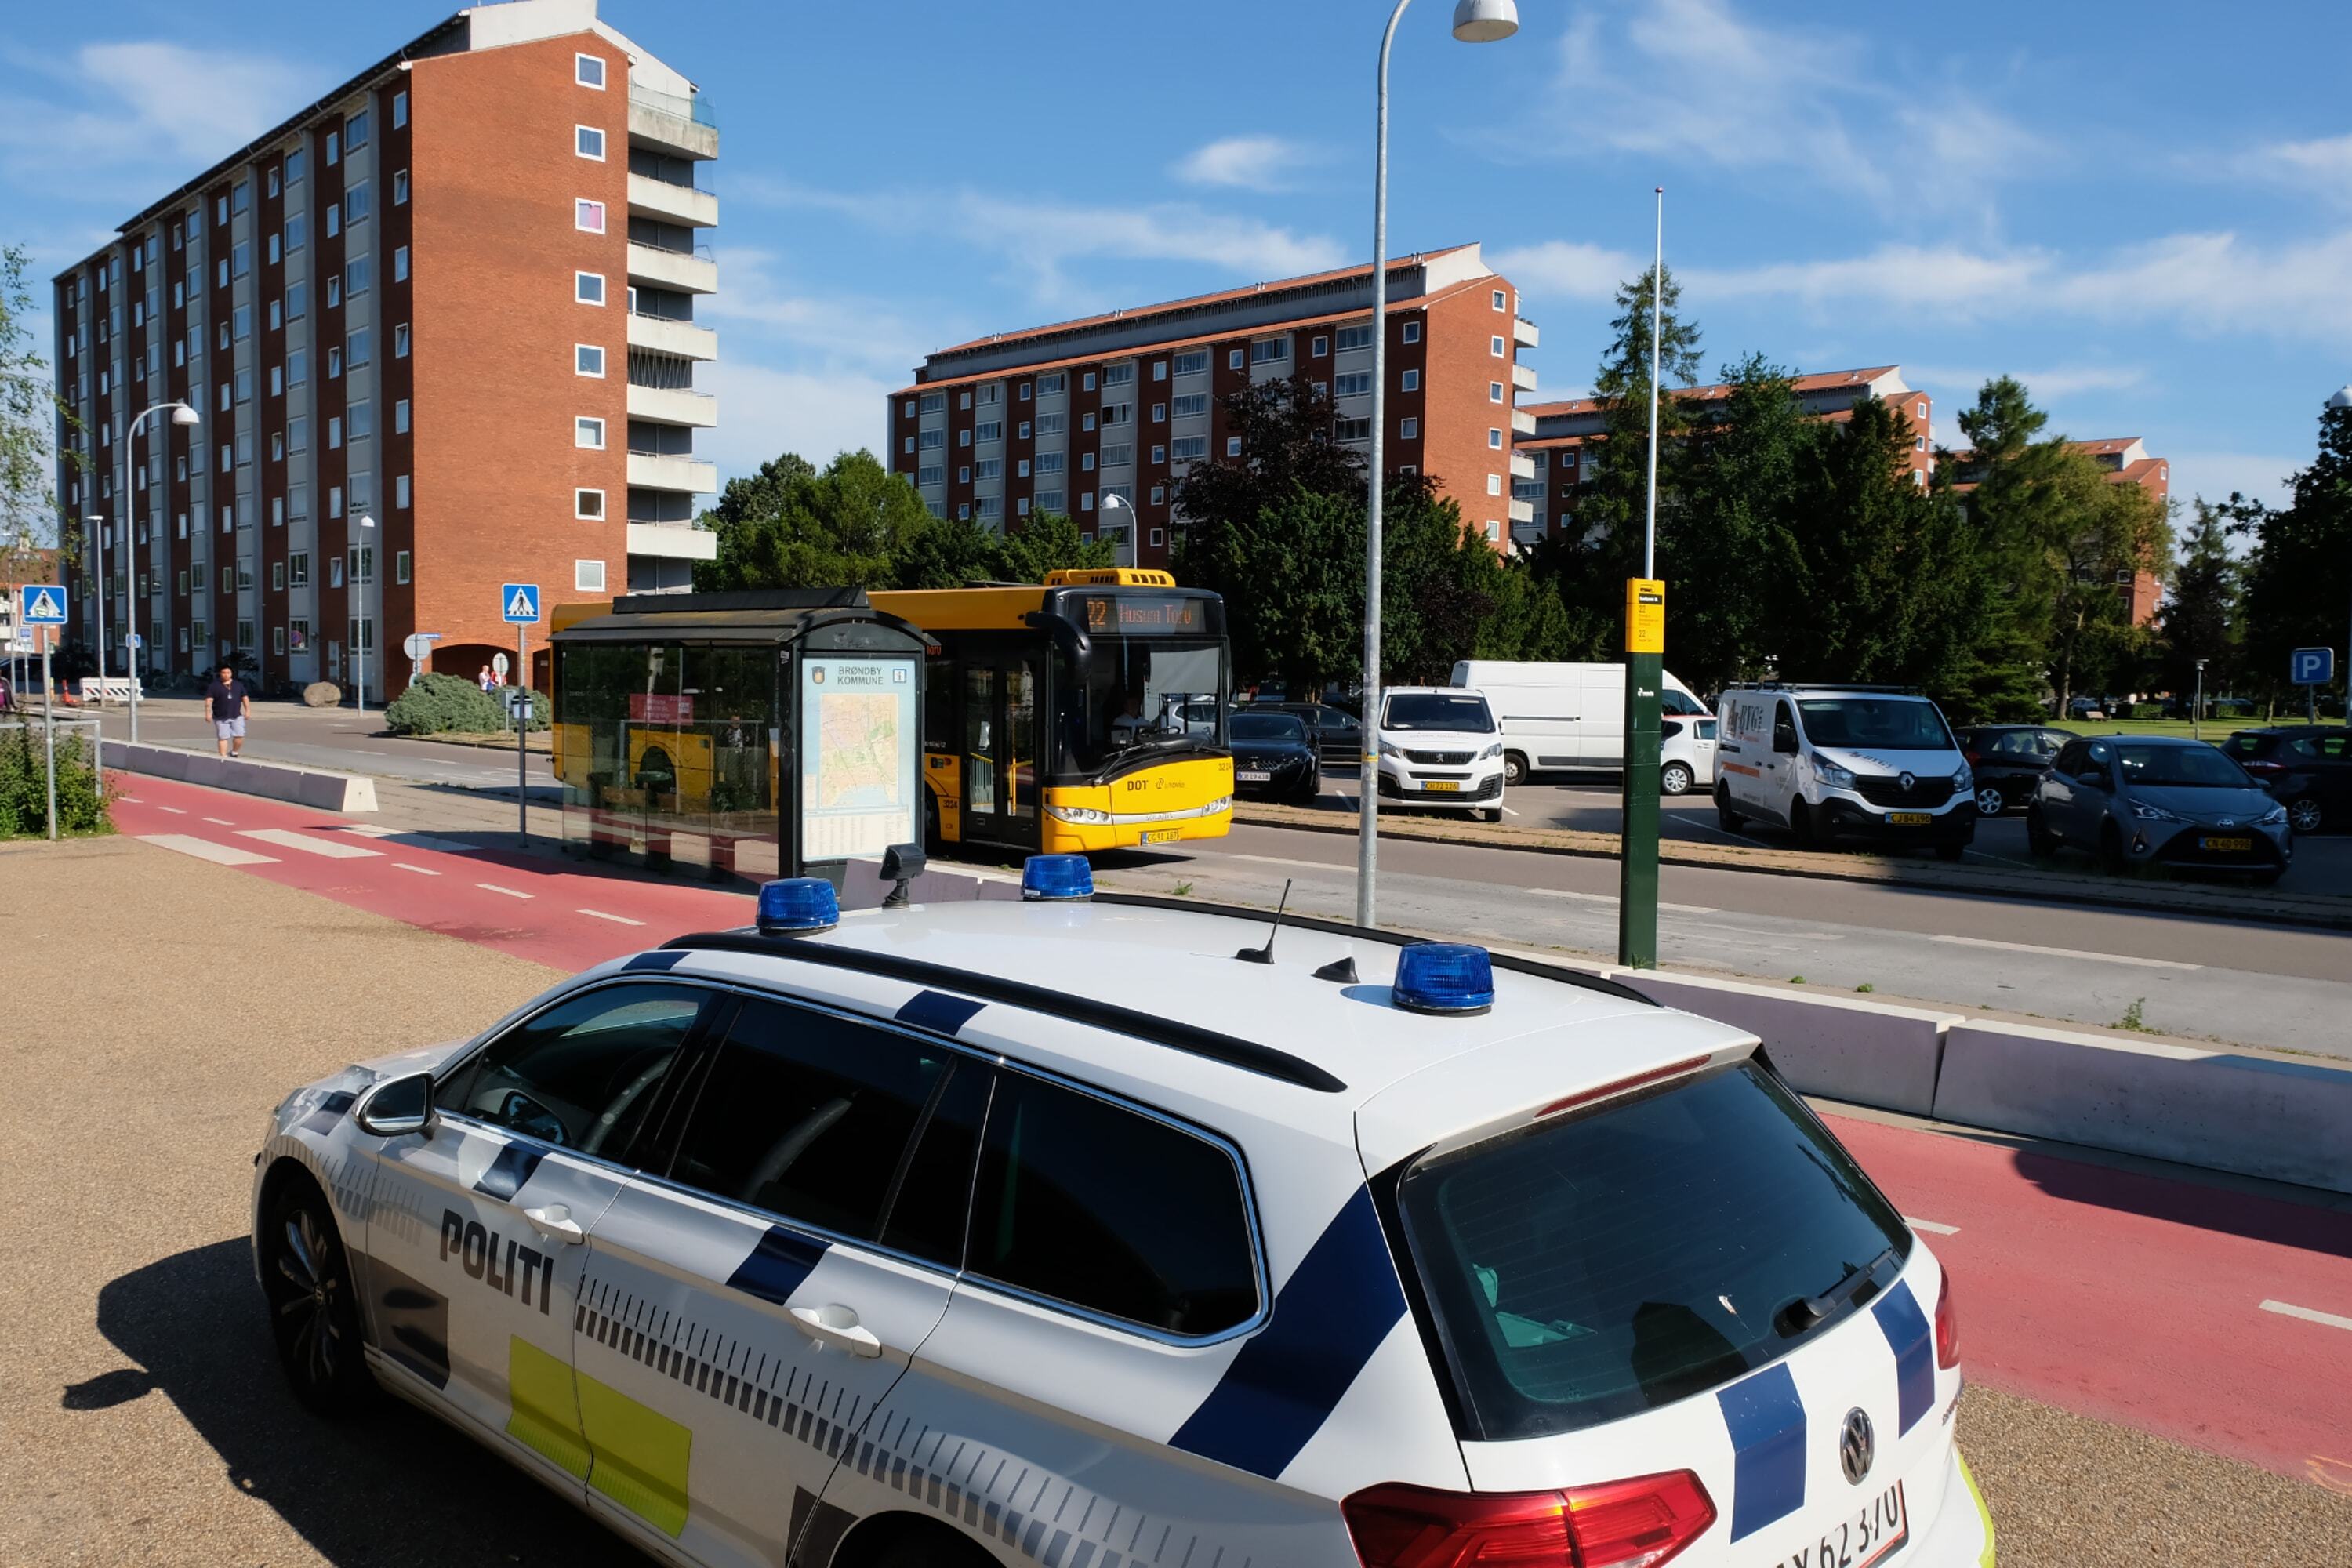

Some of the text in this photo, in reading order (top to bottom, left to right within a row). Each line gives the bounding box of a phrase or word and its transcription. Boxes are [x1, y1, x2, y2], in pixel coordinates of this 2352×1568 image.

[1087, 601, 1107, 627] 22
[1120, 604, 1160, 625] Husum
[838, 666, 882, 676] BRØNDBY
[2303, 655, 2321, 678] P
[837, 676, 884, 685] KOMMUNE
[1127, 779, 1148, 791] DOT
[440, 1208, 554, 1316] POLITI
[1820, 1522, 1852, 1568] 62
